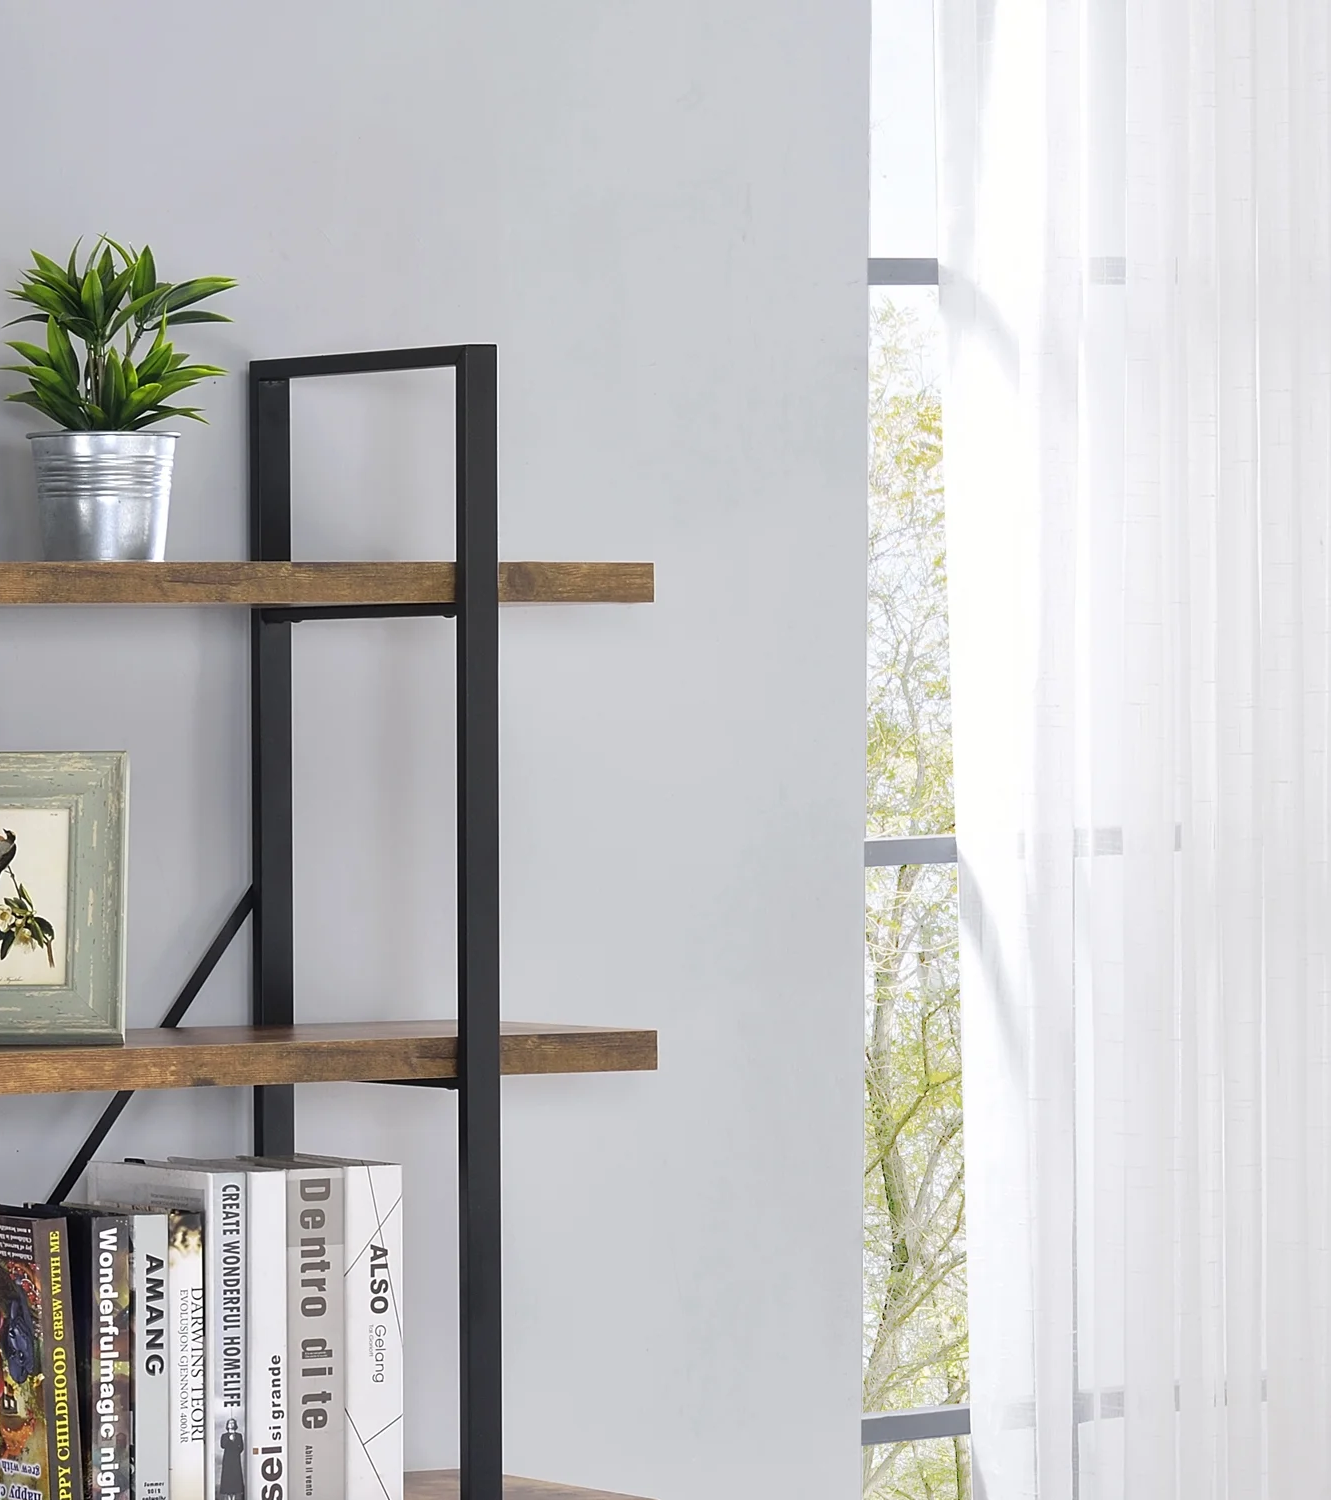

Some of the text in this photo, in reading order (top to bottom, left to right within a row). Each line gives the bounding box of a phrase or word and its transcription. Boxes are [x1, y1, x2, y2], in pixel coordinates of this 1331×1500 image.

[11, 1235, 32, 1243] Childhood
[12, 1252, 33, 1260] Childhood
[50, 1231, 60, 1253] ME
[300, 1178, 331, 1318] Dentro
[51, 1257, 61, 1295] WITH
[222, 1184, 241, 1407] CREATE WONDERFUL HOMELIFE
[53, 1299, 63, 1340] GREW
[97, 1228, 119, 1438] Wonderfulmagic
[146, 1254, 164, 1376] AMANG
[178, 1290, 188, 1352] EVOLUSJON
[370, 1244, 389, 1383] ALSO Gelang
[191, 1288, 205, 1442] DARWINS TEORI
[301, 1338, 333, 1377] di
[178, 1355, 188, 1409] GJENNOM
[269, 1355, 284, 1420] grande
[53, 1347, 70, 1461] CHILDHOOD
[302, 1391, 331, 1429] te
[269, 1425, 281, 1441] si
[2, 1459, 19, 1473] with
[22, 1464, 40, 1476] grew
[305, 1475, 313, 1496] vento
